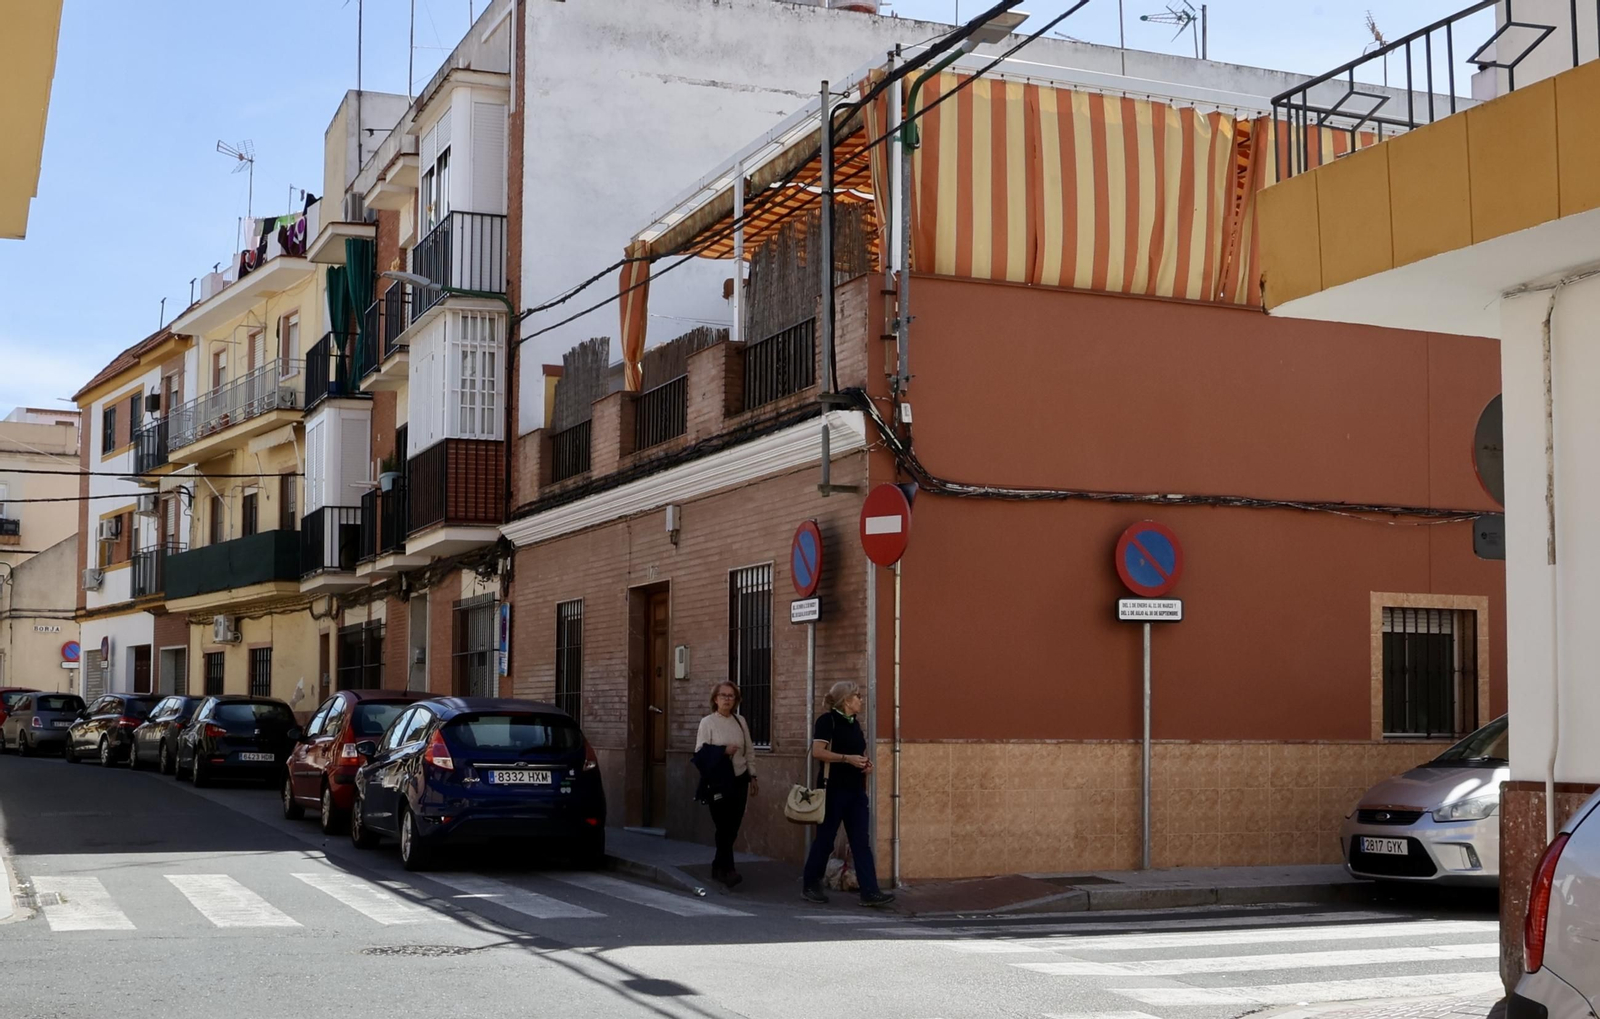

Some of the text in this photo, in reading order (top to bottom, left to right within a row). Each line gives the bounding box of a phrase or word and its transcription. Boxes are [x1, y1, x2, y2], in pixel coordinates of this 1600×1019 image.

[498, 772, 548, 782] 8332 HXM
[1365, 839, 1403, 853] 2817 GYK
